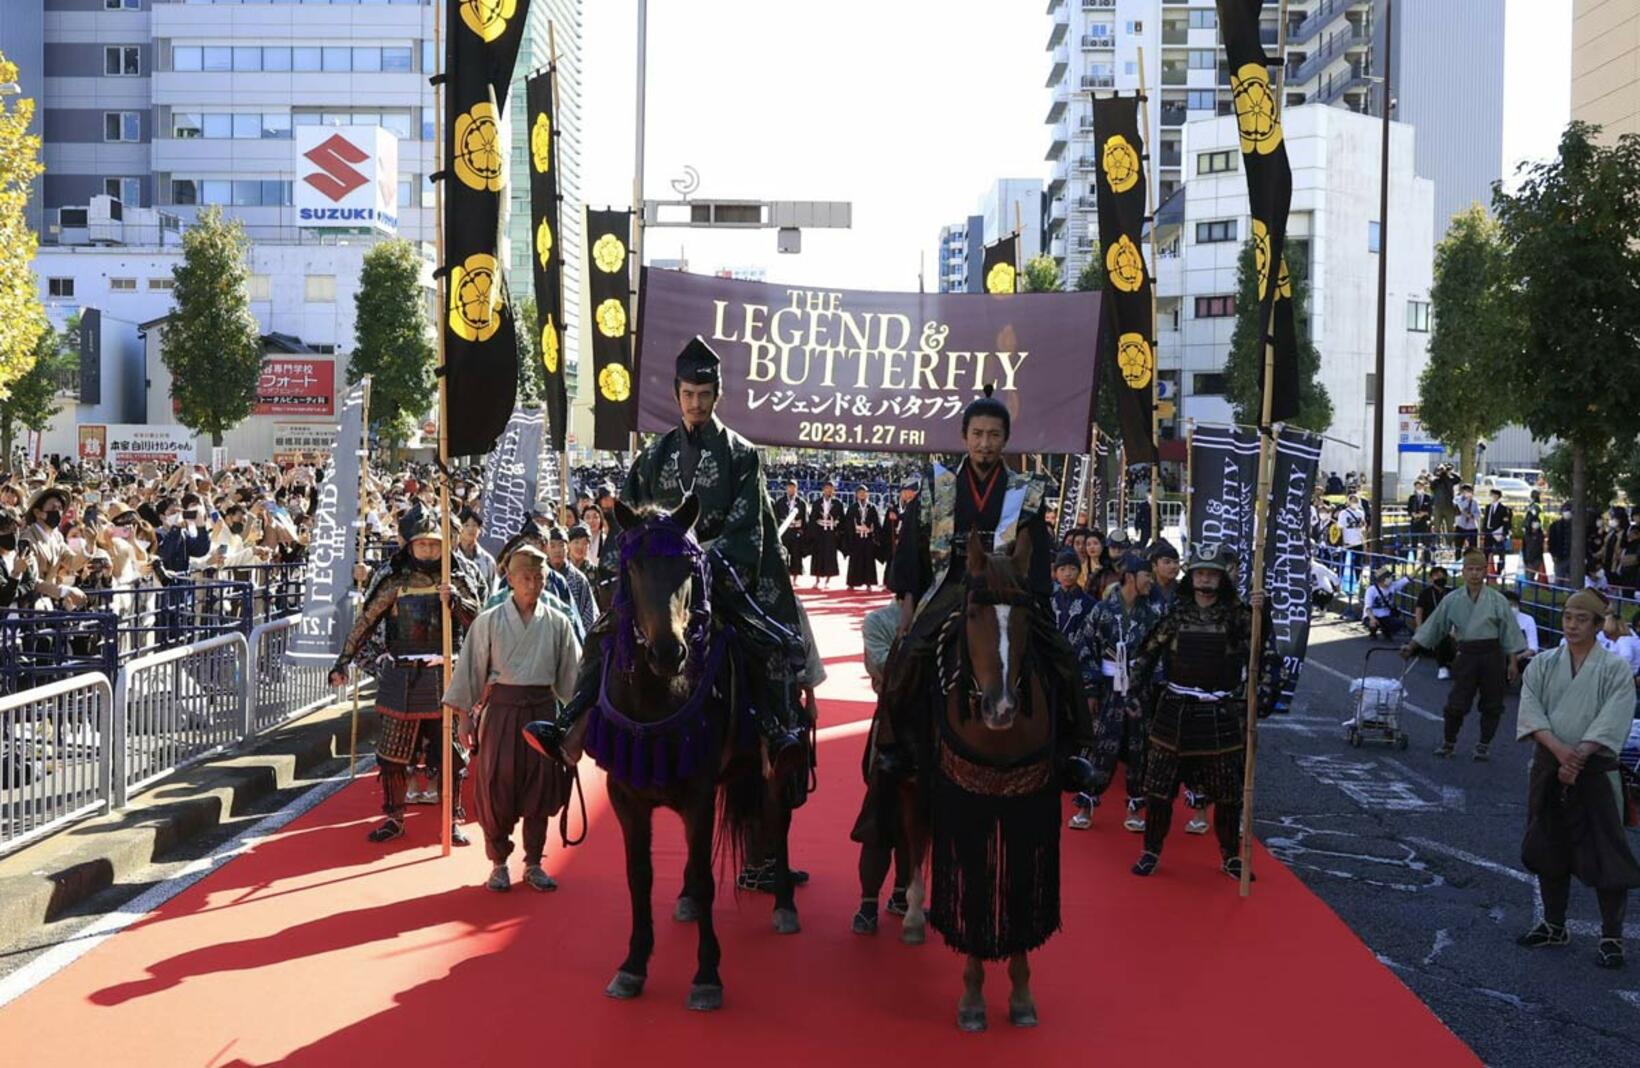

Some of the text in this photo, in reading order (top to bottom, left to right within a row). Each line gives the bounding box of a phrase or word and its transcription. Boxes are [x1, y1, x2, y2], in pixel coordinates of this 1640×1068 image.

[300, 207, 374, 220] SUZUKI
[786, 290, 843, 313] THE
[711, 300, 950, 353] LEGEND &
[745, 342, 1029, 391] BUTTERFLY
[747, 388, 967, 420] レジェンド&バタフラ
[798, 421, 926, 445] 2023.1.27 FRI
